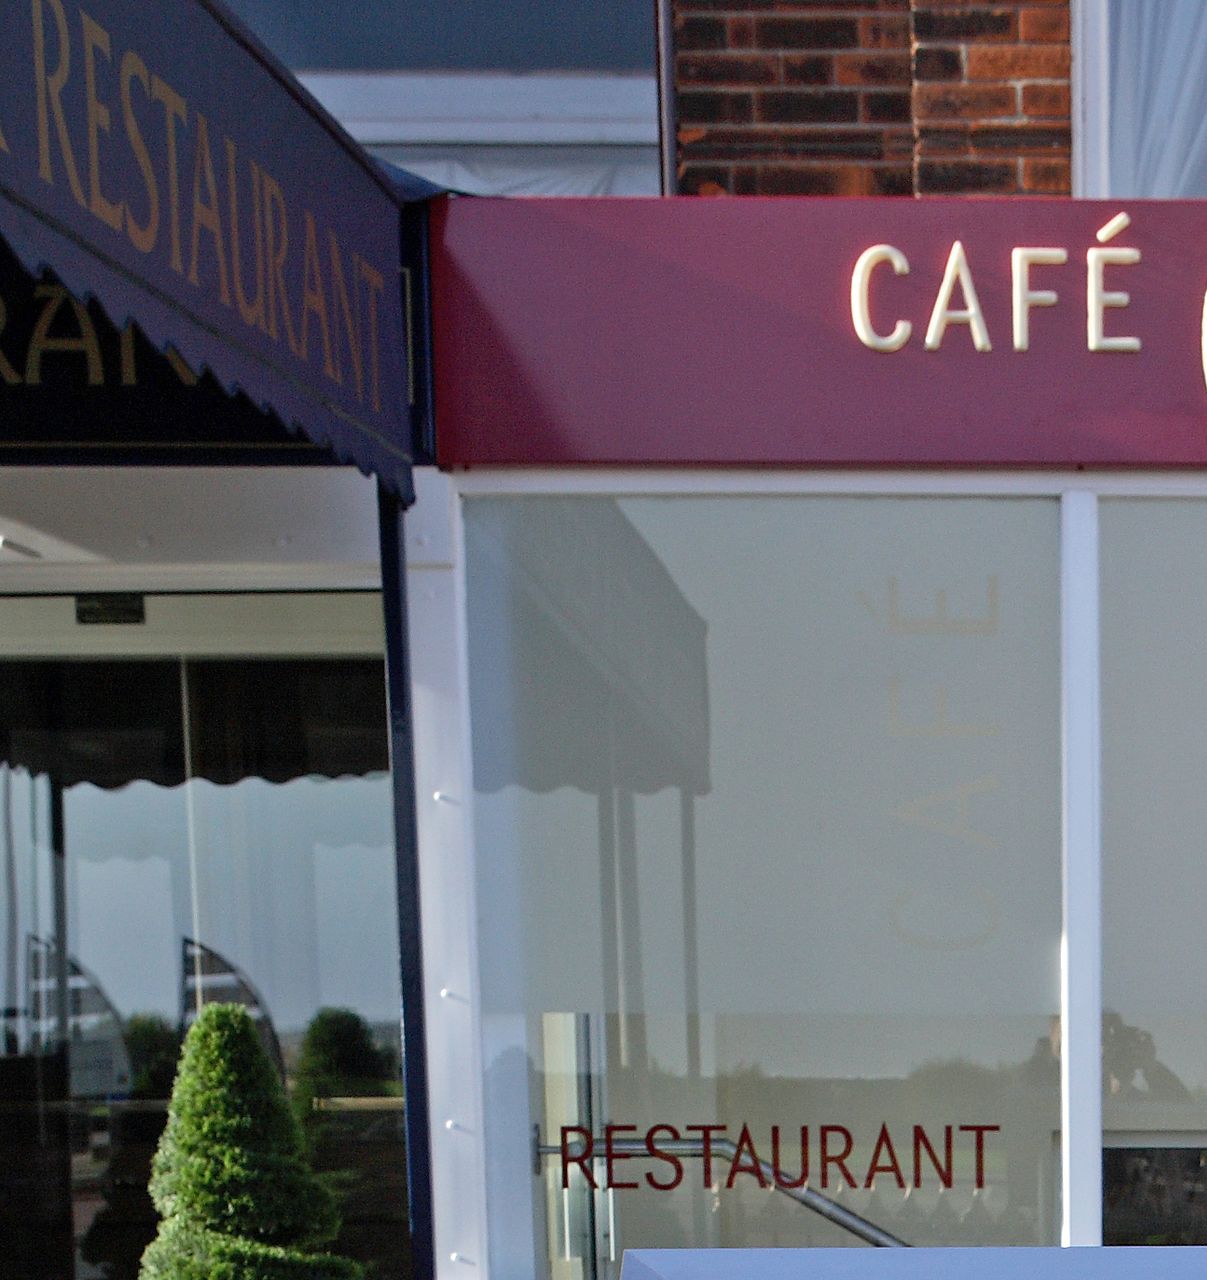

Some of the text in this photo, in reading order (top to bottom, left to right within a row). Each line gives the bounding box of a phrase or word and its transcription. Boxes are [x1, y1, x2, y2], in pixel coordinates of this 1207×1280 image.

[31, 0, 385, 413] RESTAURANT
[849, 210, 1142, 353] CAFÉ
[559, 1121, 1001, 1191] RESTAURANT
